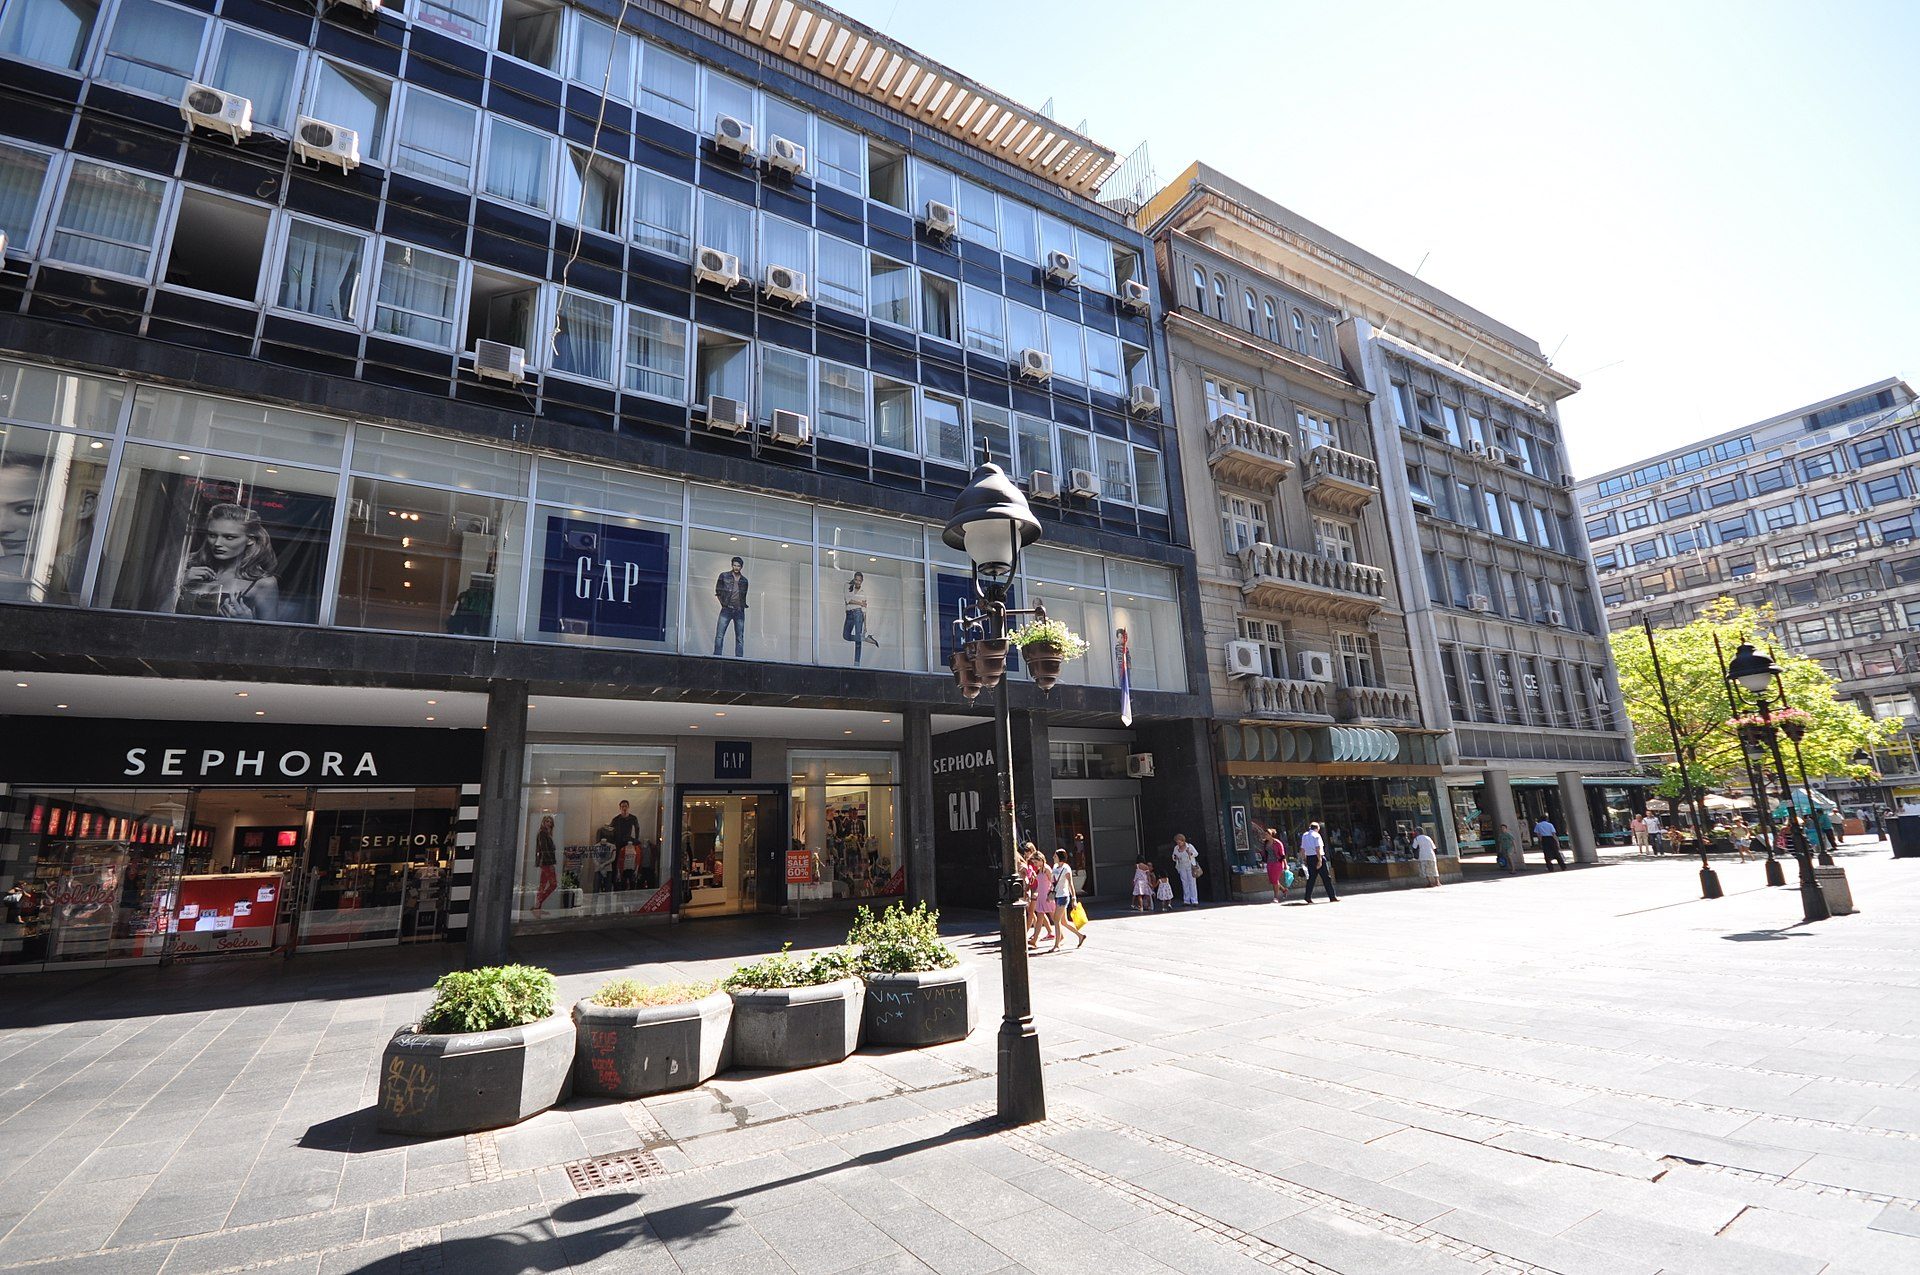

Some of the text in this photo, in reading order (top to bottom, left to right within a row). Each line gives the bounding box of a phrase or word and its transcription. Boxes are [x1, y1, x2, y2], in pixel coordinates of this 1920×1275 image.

[575, 556, 640, 603] GAP
[123, 747, 378, 777] SEPHORA
[723, 752, 745, 768] GAP
[933, 749, 995, 775] SEPHORA
[948, 790, 980, 832] GAP
[787, 859, 809, 867] SALE
[787, 868, 809, 877] 60%
